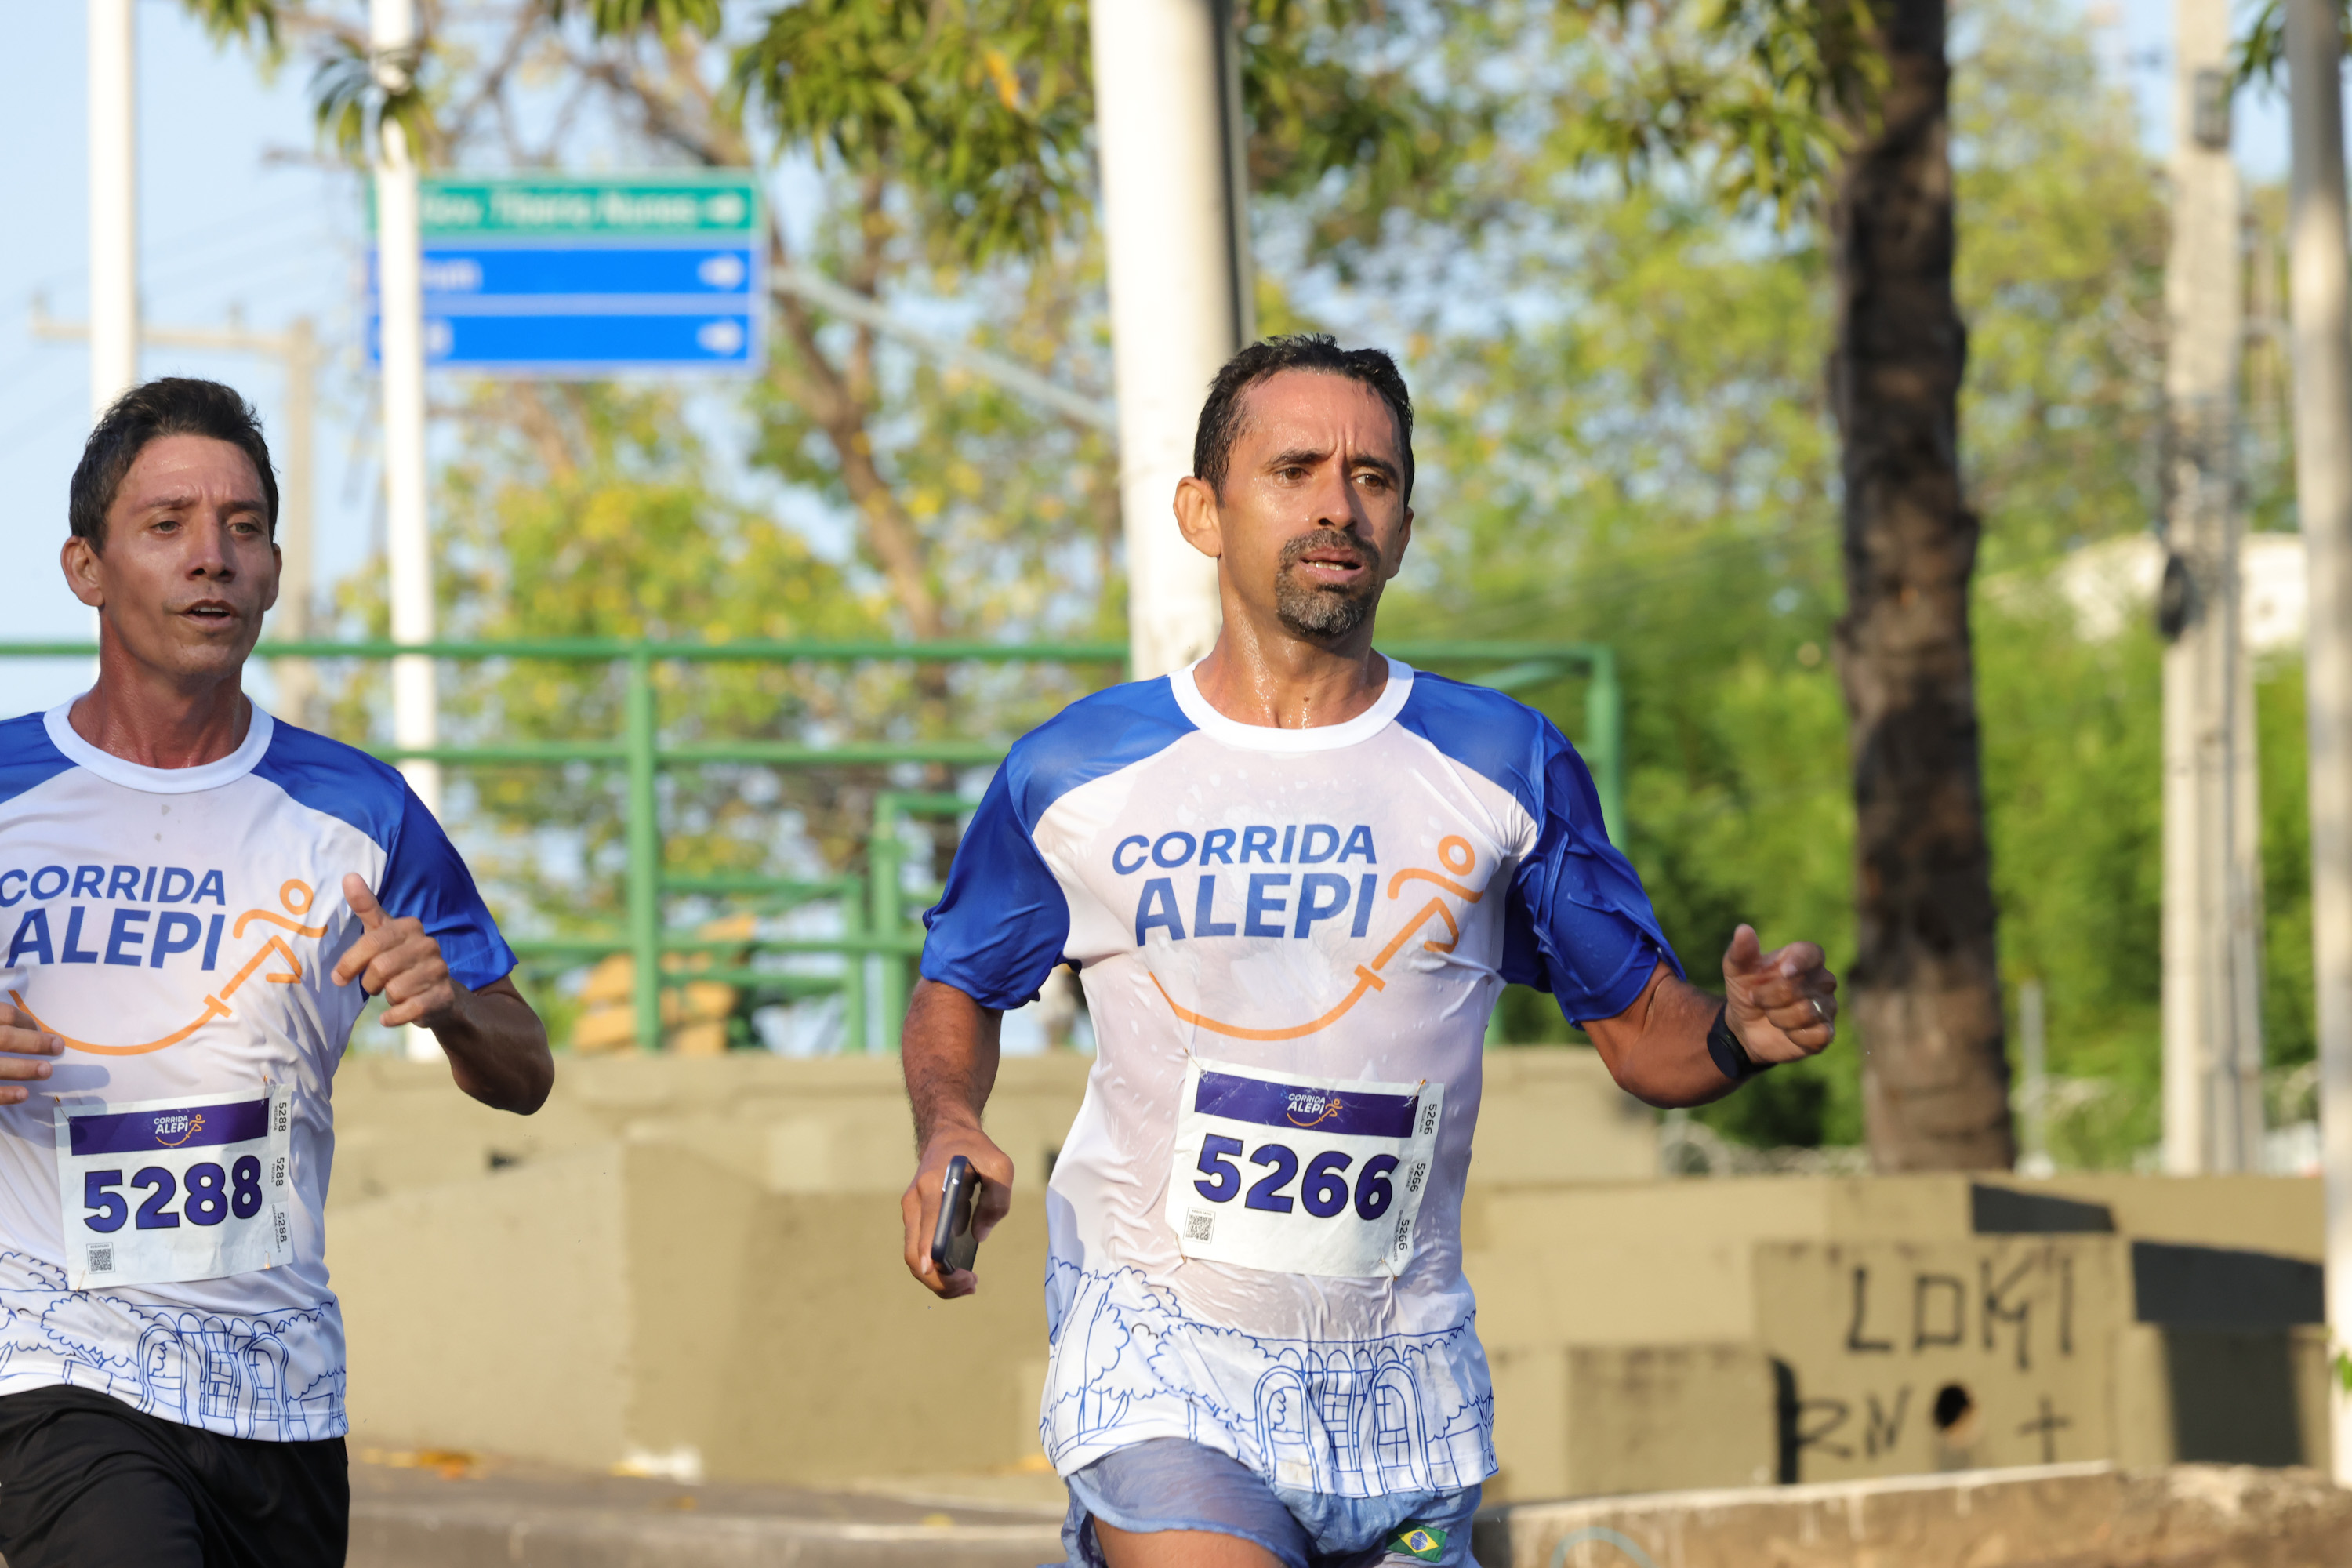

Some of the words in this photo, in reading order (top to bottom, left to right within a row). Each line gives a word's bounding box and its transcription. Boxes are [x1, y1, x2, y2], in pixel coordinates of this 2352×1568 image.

[1112, 824, 1377, 875] CORRIDA
[0, 865, 226, 907] CORRIDA
[1136, 873, 1377, 946] ALEPI
[5, 906, 226, 971] ALEPI
[1287, 1101, 1325, 1115] ALEPI
[1288, 1093, 1326, 1105] CORRIDA
[154, 1115, 188, 1125] CORRIDA
[155, 1122, 188, 1134] ALEPI
[278, 1102, 287, 1132] 5288
[1418, 1105, 1427, 1133] MEDALHA
[1424, 1104, 1437, 1134] 5266
[275, 1157, 285, 1187] 5288
[1193, 1133, 1400, 1221] 5266
[1410, 1162, 1425, 1192] 5266
[83, 1155, 263, 1233] 5288
[277, 1212, 287, 1243] 5288
[1399, 1219, 1410, 1250] 5266
